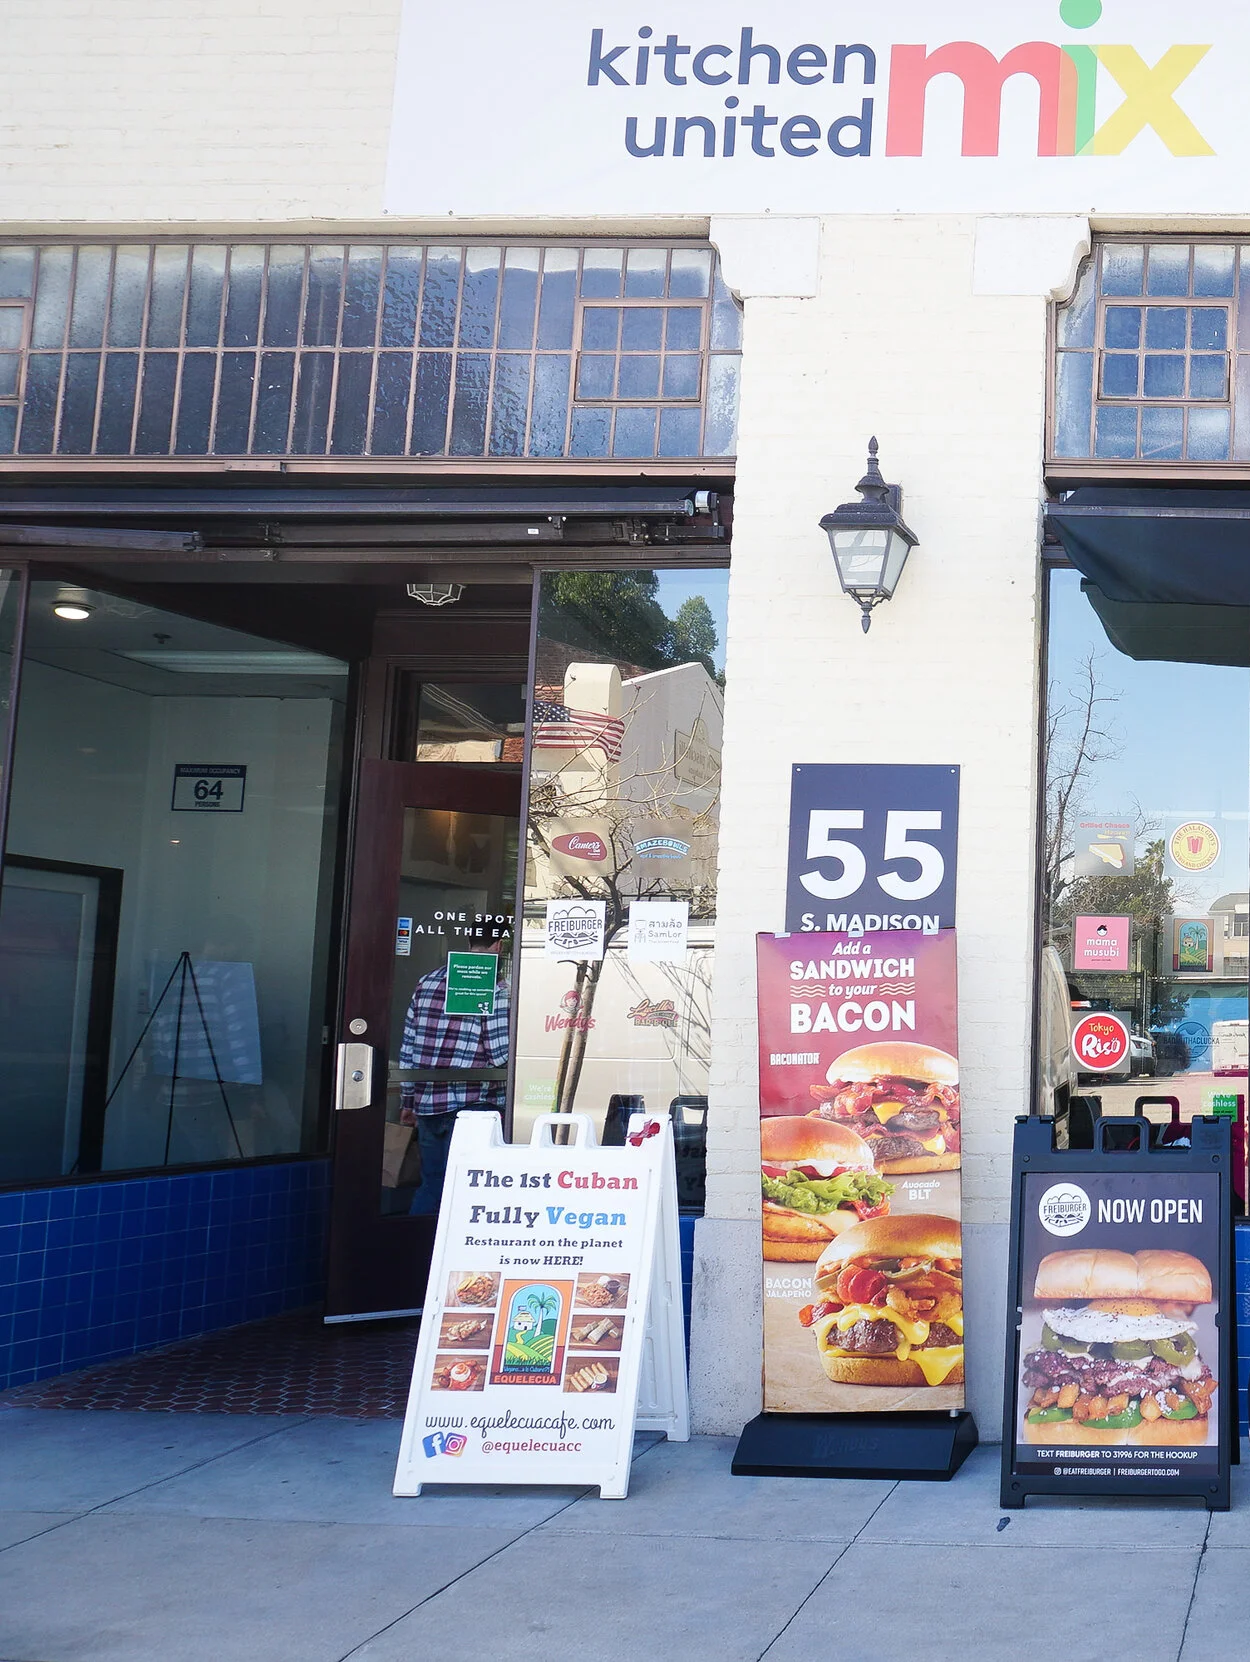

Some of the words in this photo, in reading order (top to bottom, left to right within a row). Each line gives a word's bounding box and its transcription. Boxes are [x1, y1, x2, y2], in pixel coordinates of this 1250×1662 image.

[587, 26, 876, 87] kitchen
[884, 0, 1217, 158] mix
[623, 96, 873, 159] united
[194, 779, 224, 801] 64
[1174, 832, 1184, 845] THE
[1182, 825, 1205, 834] HALAL
[1204, 830, 1217, 846] GUYS
[635, 839, 689, 853] AMAZEBOWLS
[799, 809, 945, 901] 55
[434, 911, 467, 922] ONE
[475, 913, 516, 925] SPOT.
[800, 913, 821, 932] S.
[825, 913, 940, 932] MADISON
[415, 924, 445, 935] ALL
[454, 926, 484, 937] THE
[492, 928, 515, 938] EA
[548, 919, 603, 933] FREIBURGER
[648, 930, 682, 938] SamLor
[832, 942, 860, 955] Add
[862, 944, 872, 955] a
[1086, 938, 1118, 946] mama
[1084, 946, 1120, 957] musubi
[789, 957, 916, 980] SANDWICH
[828, 983, 844, 996] to
[845, 985, 879, 999] your
[790, 1000, 916, 1034] BACON
[1088, 1022, 1115, 1036] Tokyo
[1163, 1036, 1220, 1045] BADUTHACLUCKA
[769, 1052, 821, 1066] BACONATOR
[467, 1169, 514, 1188] The
[519, 1172, 552, 1189] 1st
[557, 1170, 639, 1190] Cuban
[901, 1180, 941, 1190] Avocado
[908, 1187, 932, 1202] BLT
[1043, 1202, 1088, 1215] FREIBURGER
[1098, 1199, 1147, 1224] NOW
[1150, 1199, 1204, 1224] OPEN
[469, 1205, 540, 1229] Fully
[545, 1206, 627, 1230] Vegan
[464, 1235, 537, 1247] Restaurant
[538, 1239, 555, 1247] on
[557, 1237, 579, 1247] the
[580, 1238, 624, 1250] planet
[499, 1255, 511, 1265] is
[512, 1257, 541, 1266] now
[542, 1255, 584, 1266] HERE!
[765, 1277, 812, 1290] BACON
[493, 1375, 557, 1384] EQUELECUA
[425, 1409, 616, 1440] www.equelecuacafe.com
[481, 1438, 582, 1455] @equelecuacc
[1037, 1450, 1054, 1458] TEXT
[1055, 1450, 1100, 1459] FREIBURGER
[1112, 1451, 1133, 1459] 31996
[1133, 1451, 1150, 1459] FOR
[1150, 1451, 1165, 1459] THE
[1165, 1451, 1198, 1460] HOOKUP
[1062, 1467, 1112, 1476] @EATFREIBURGER
[1117, 1468, 1180, 1476] FREIBURGERTOGO.COM
